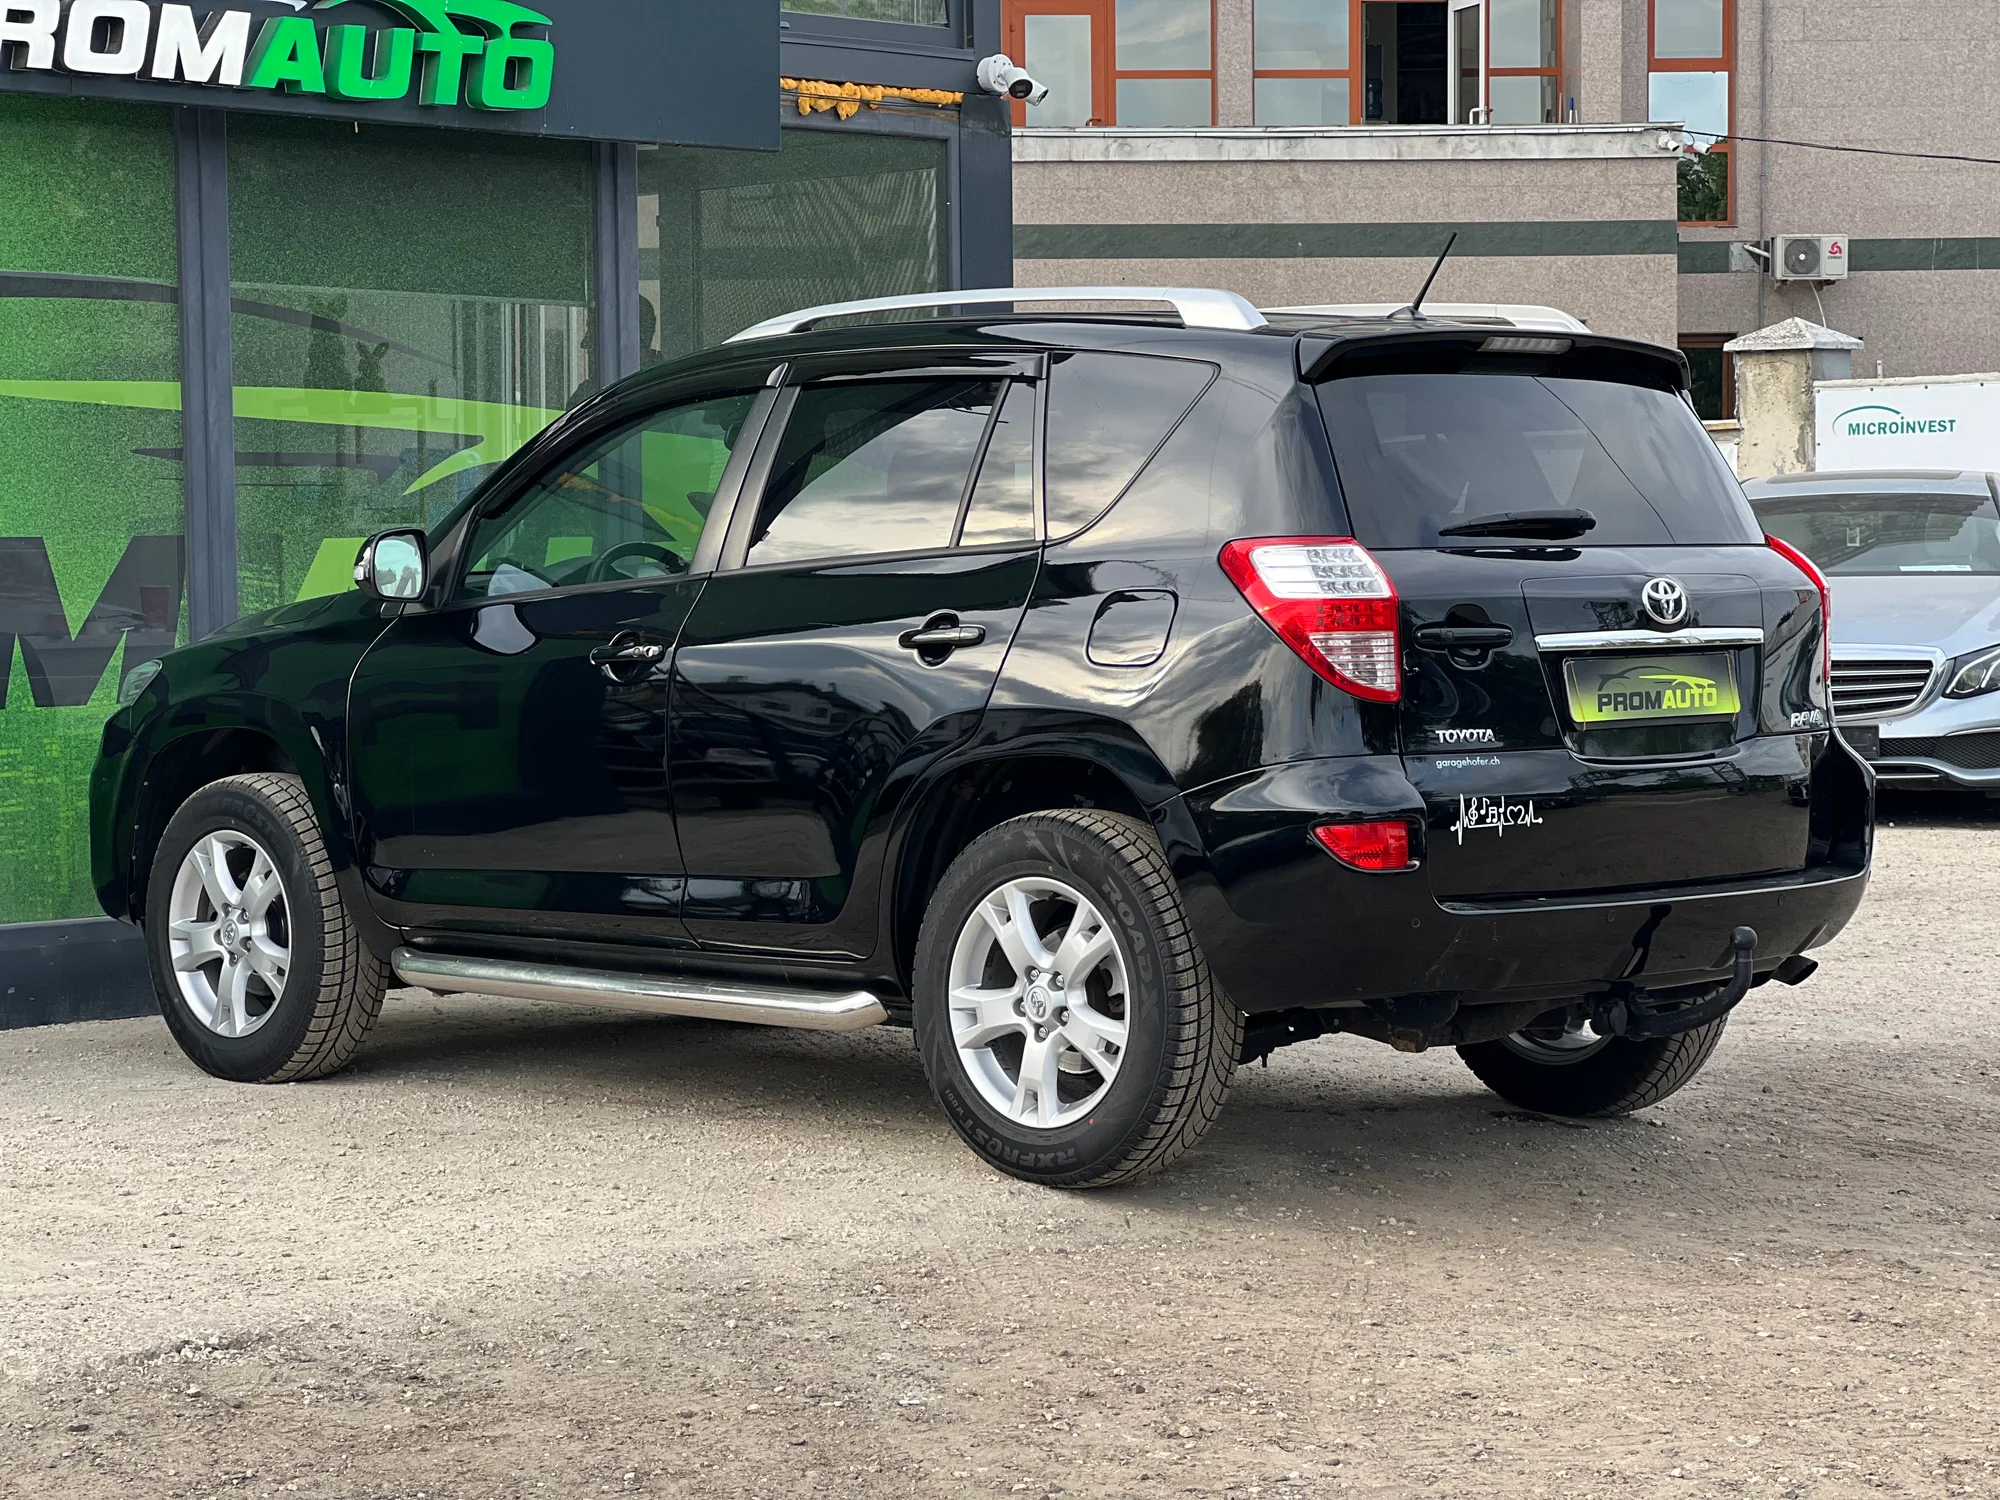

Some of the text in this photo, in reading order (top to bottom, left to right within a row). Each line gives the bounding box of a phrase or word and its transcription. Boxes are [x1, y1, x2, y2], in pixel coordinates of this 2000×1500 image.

[1597, 687, 1718, 713] PROMAUTO
[1435, 728, 1496, 743] TOYOTA
[1435, 755, 1501, 769] garagehofer.ch
[1101, 876, 1160, 1025] ROADX
[959, 1118, 1078, 1168] RXFROST
